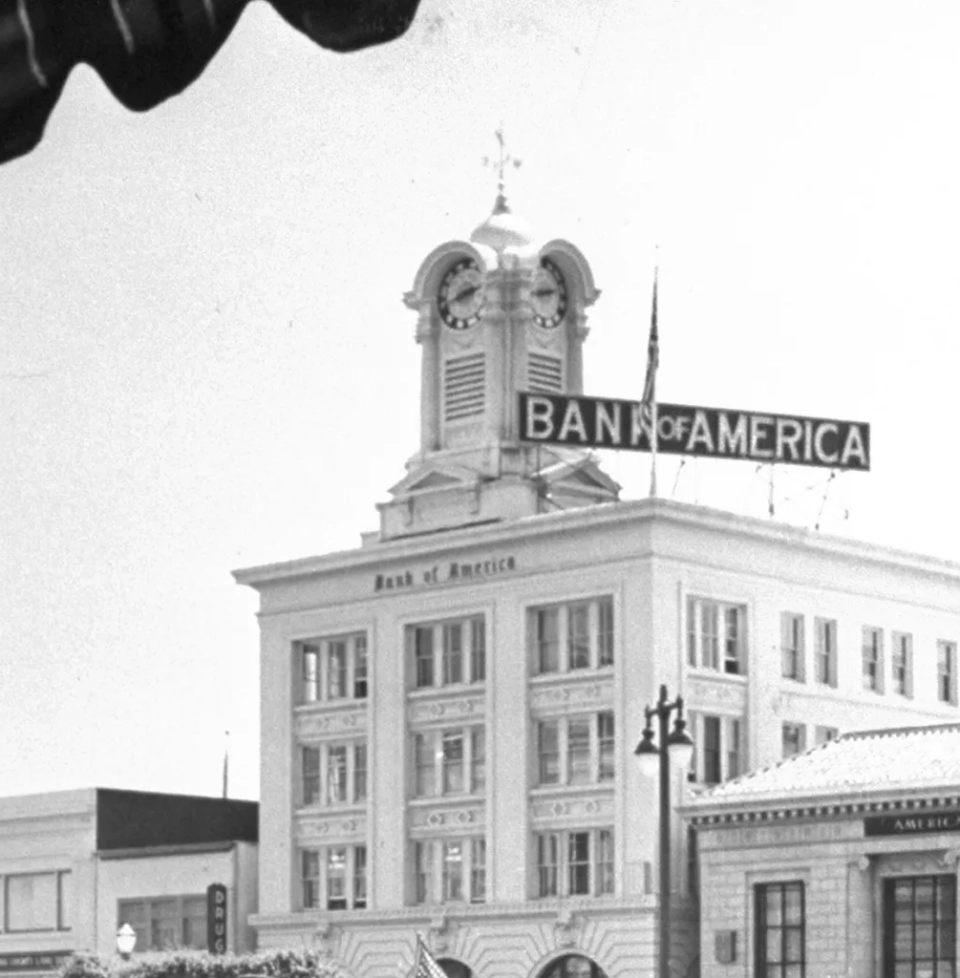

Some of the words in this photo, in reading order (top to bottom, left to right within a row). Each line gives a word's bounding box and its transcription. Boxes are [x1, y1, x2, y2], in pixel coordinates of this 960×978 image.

[525, 395, 657, 447] BANK
[657, 415, 690, 441] OF
[687, 409, 869, 466] AMERICA
[374, 570, 413, 592] Bank
[423, 565, 439, 583] of
[449, 556, 516, 578] America
[894, 815, 960, 830] AMERIC
